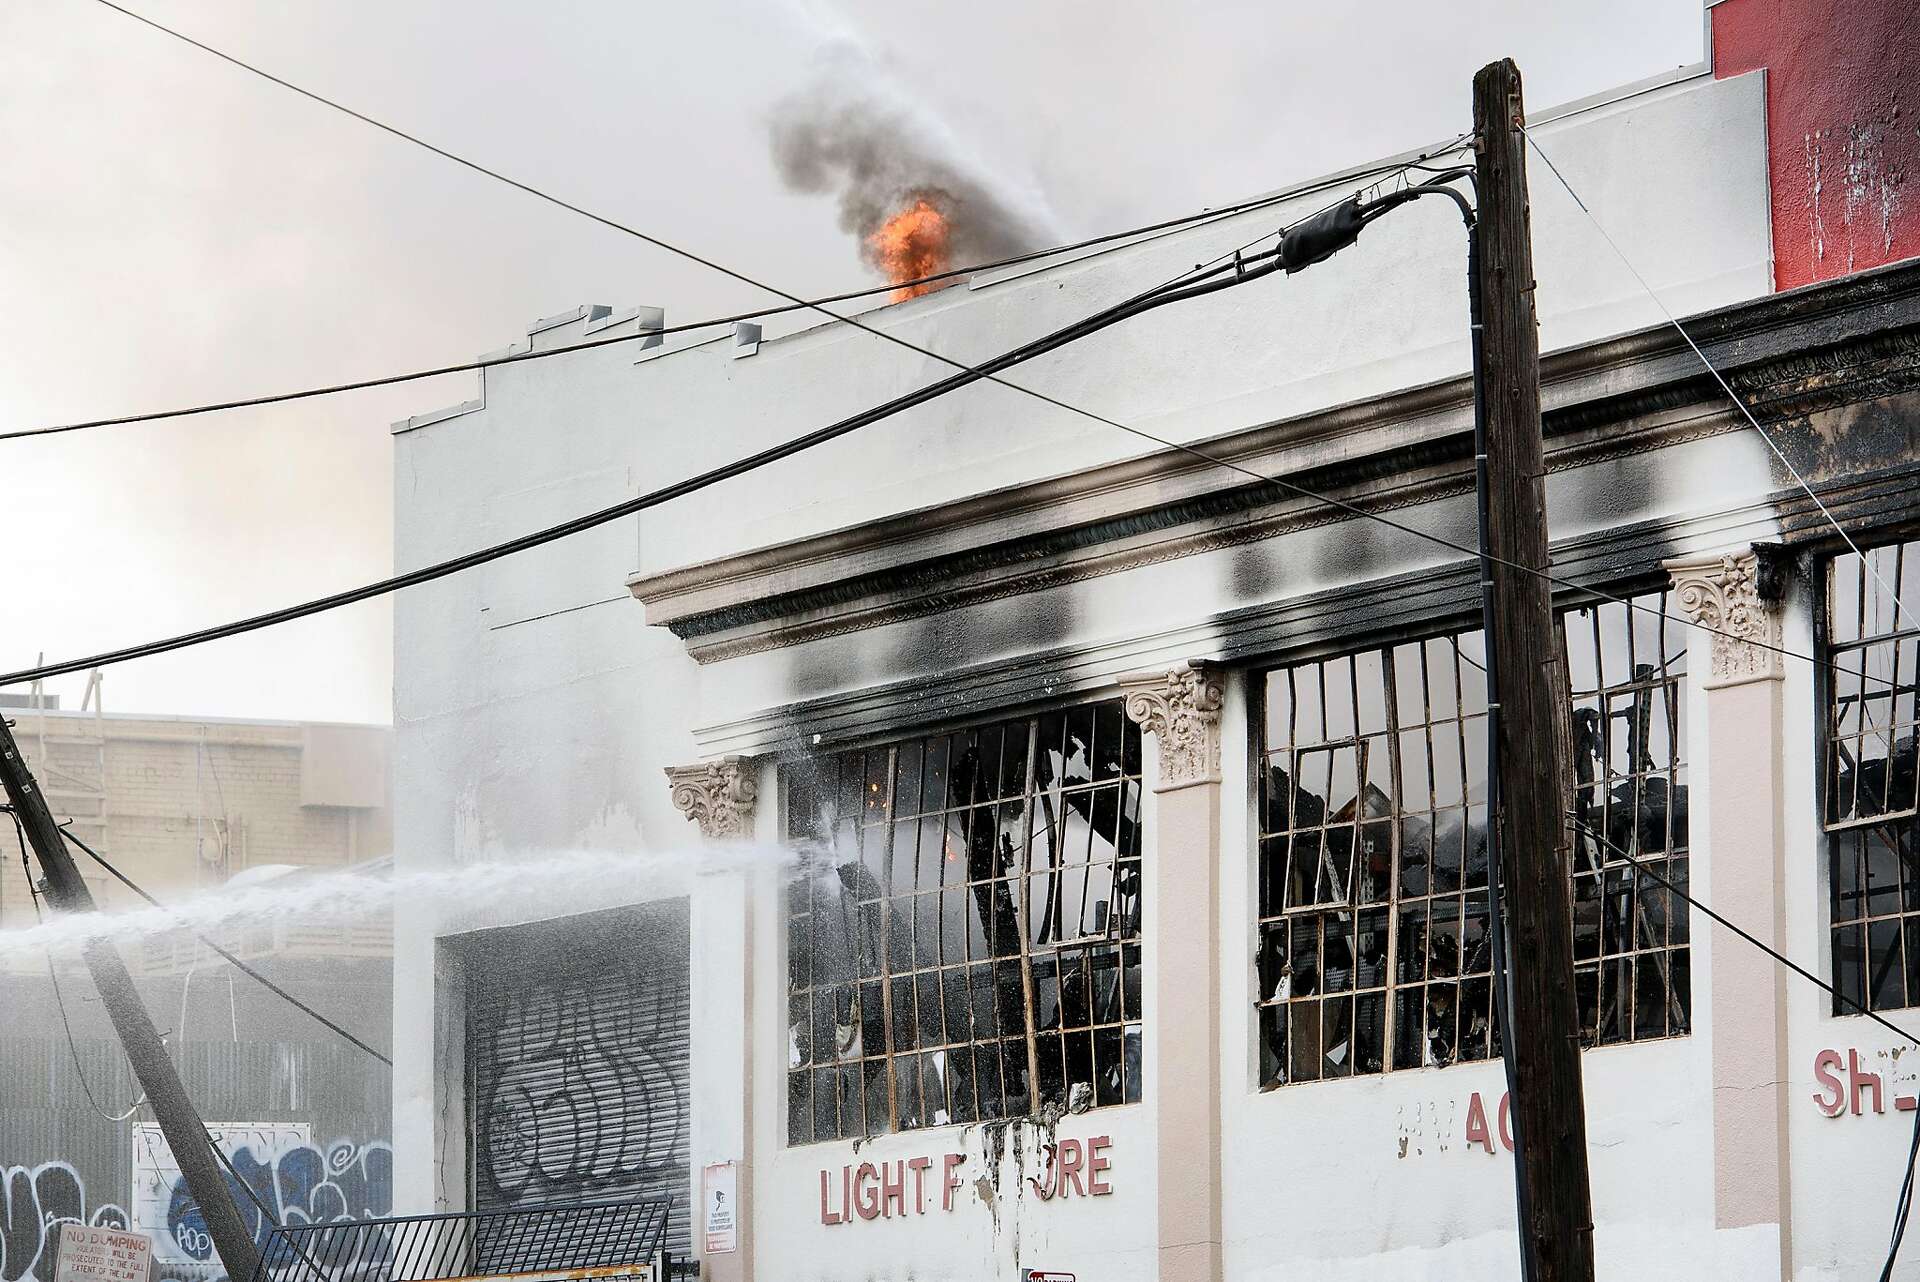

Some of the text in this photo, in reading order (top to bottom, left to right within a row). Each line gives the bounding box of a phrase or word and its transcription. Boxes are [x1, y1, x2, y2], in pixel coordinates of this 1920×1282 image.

[820, 1155, 932, 1225] LIGHT
[67, 1231, 85, 1243] NO
[90, 1233, 146, 1252] DUMPING
[112, 1249, 125, 1259] WILL
[127, 1251, 137, 1260] BE
[71, 1263, 97, 1273] EXTENT
[98, 1267, 106, 1275] OF
[109, 1268, 120, 1278] THE
[122, 1271, 136, 1280] LAW
[117, 1260, 128, 1269] THE
[130, 1262, 145, 1272] FULL
